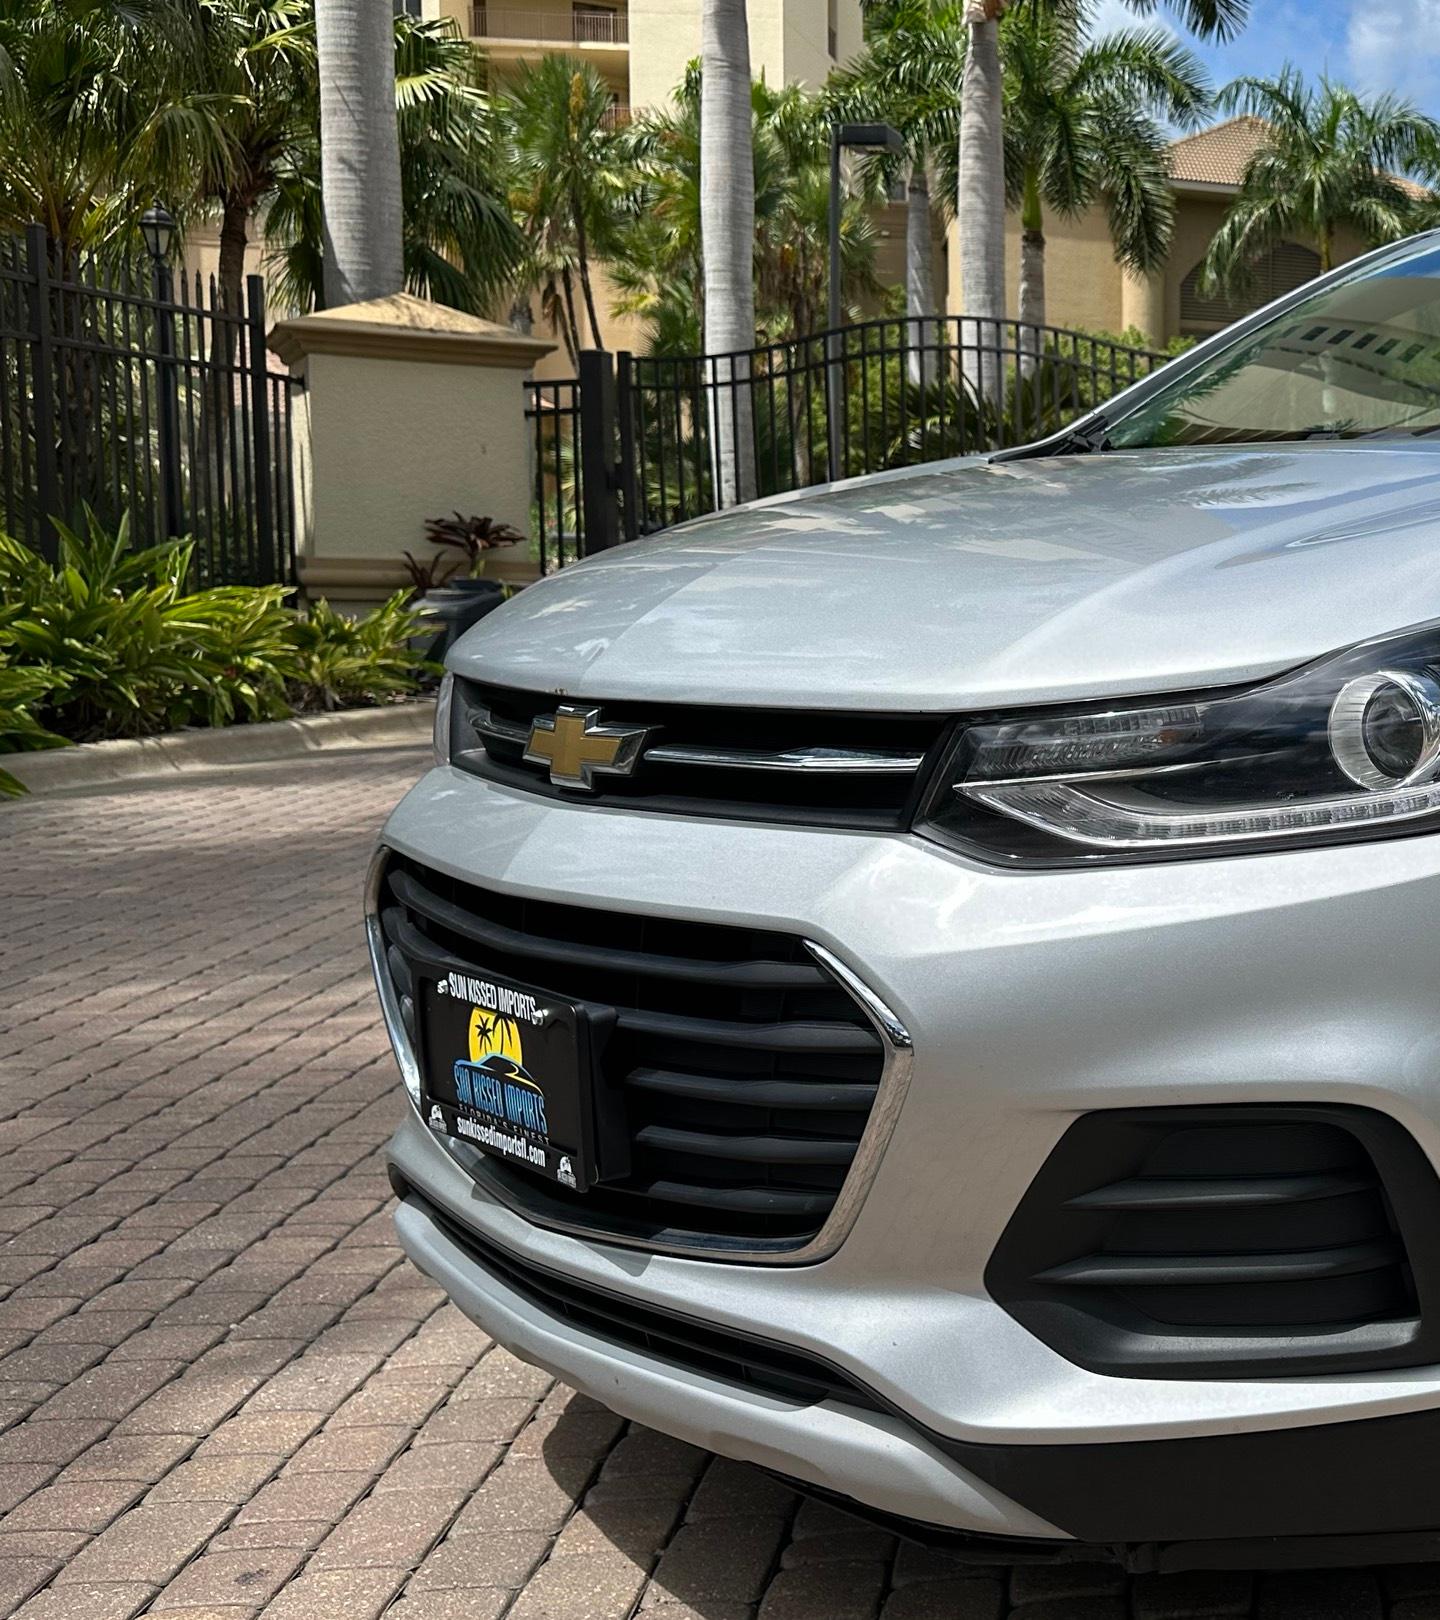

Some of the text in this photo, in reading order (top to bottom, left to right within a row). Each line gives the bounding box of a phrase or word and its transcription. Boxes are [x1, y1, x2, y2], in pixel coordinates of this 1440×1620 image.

[448, 972, 537, 1025] SUN KISSED IMPORTS
[454, 1065, 548, 1135] SUN KISSED IMPORTS
[457, 1117, 546, 1168] sunkissedimportsfl.com
[513, 1126, 550, 1145] FINEST
